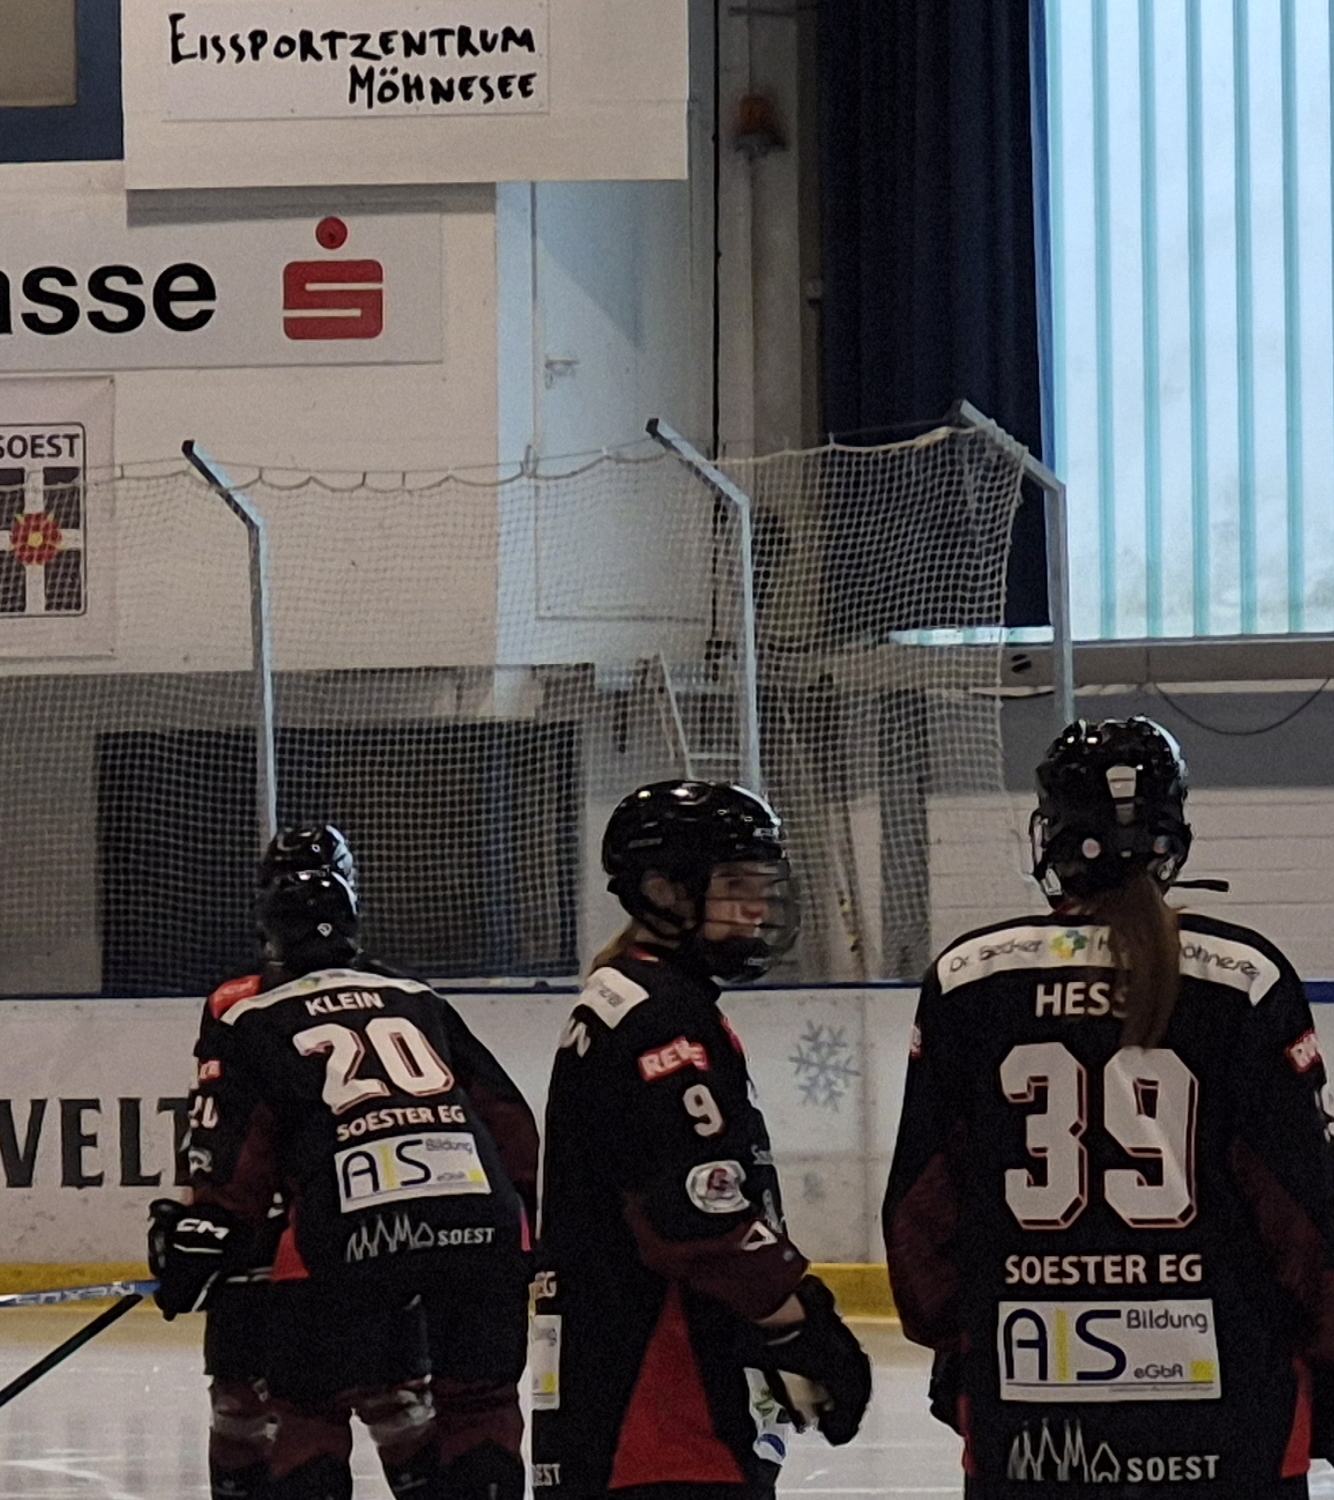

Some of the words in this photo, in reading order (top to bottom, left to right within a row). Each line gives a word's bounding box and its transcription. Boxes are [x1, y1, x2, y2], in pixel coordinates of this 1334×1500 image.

[306, 992, 385, 1016] KLEIN
[292, 1016, 455, 1115] 20
[336, 1106, 435, 1142] SOESTER
[438, 1105, 466, 1123] EG
[682, 1084, 724, 1138] 9
[1000, 1042, 1199, 1230] 39
[437, 1227, 495, 1247] SOEST
[1005, 1255, 1148, 1284] SOESTER
[1159, 1254, 1203, 1283] EG
[1003, 1308, 1127, 1381] AIS
[1126, 1309, 1209, 1334] Bildung
[1127, 1455, 1220, 1482] SOEST
